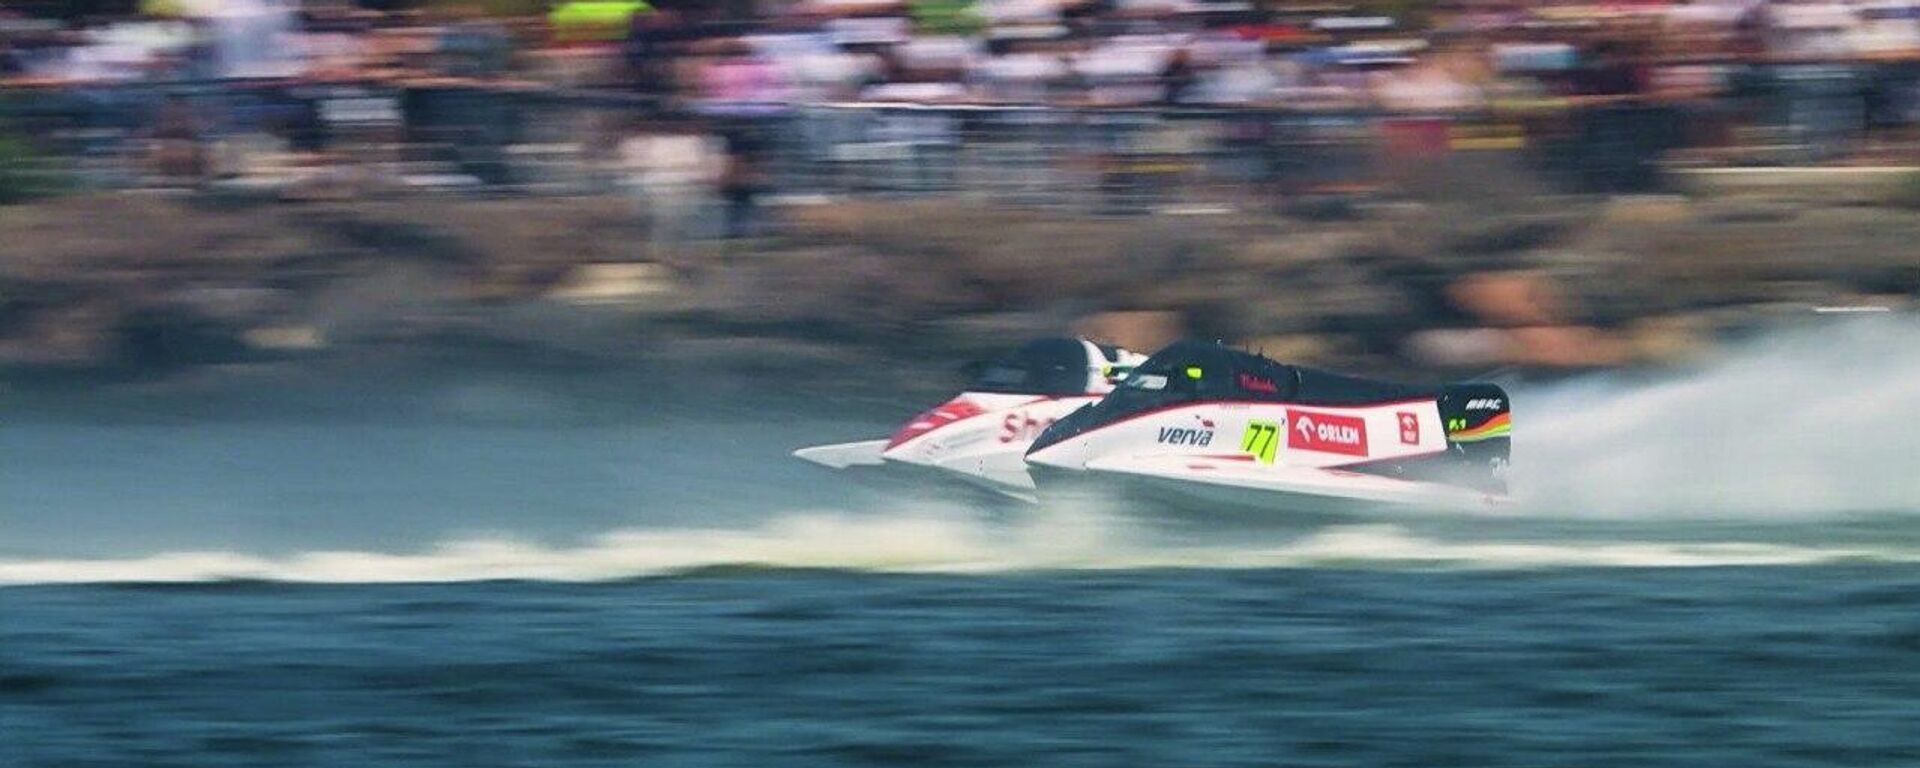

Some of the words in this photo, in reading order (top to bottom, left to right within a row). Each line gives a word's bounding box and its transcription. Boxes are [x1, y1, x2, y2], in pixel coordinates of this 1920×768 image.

[1158, 427, 1214, 447] verva
[1246, 424, 1276, 459] 77
[1317, 422, 1361, 446] ORLEN
